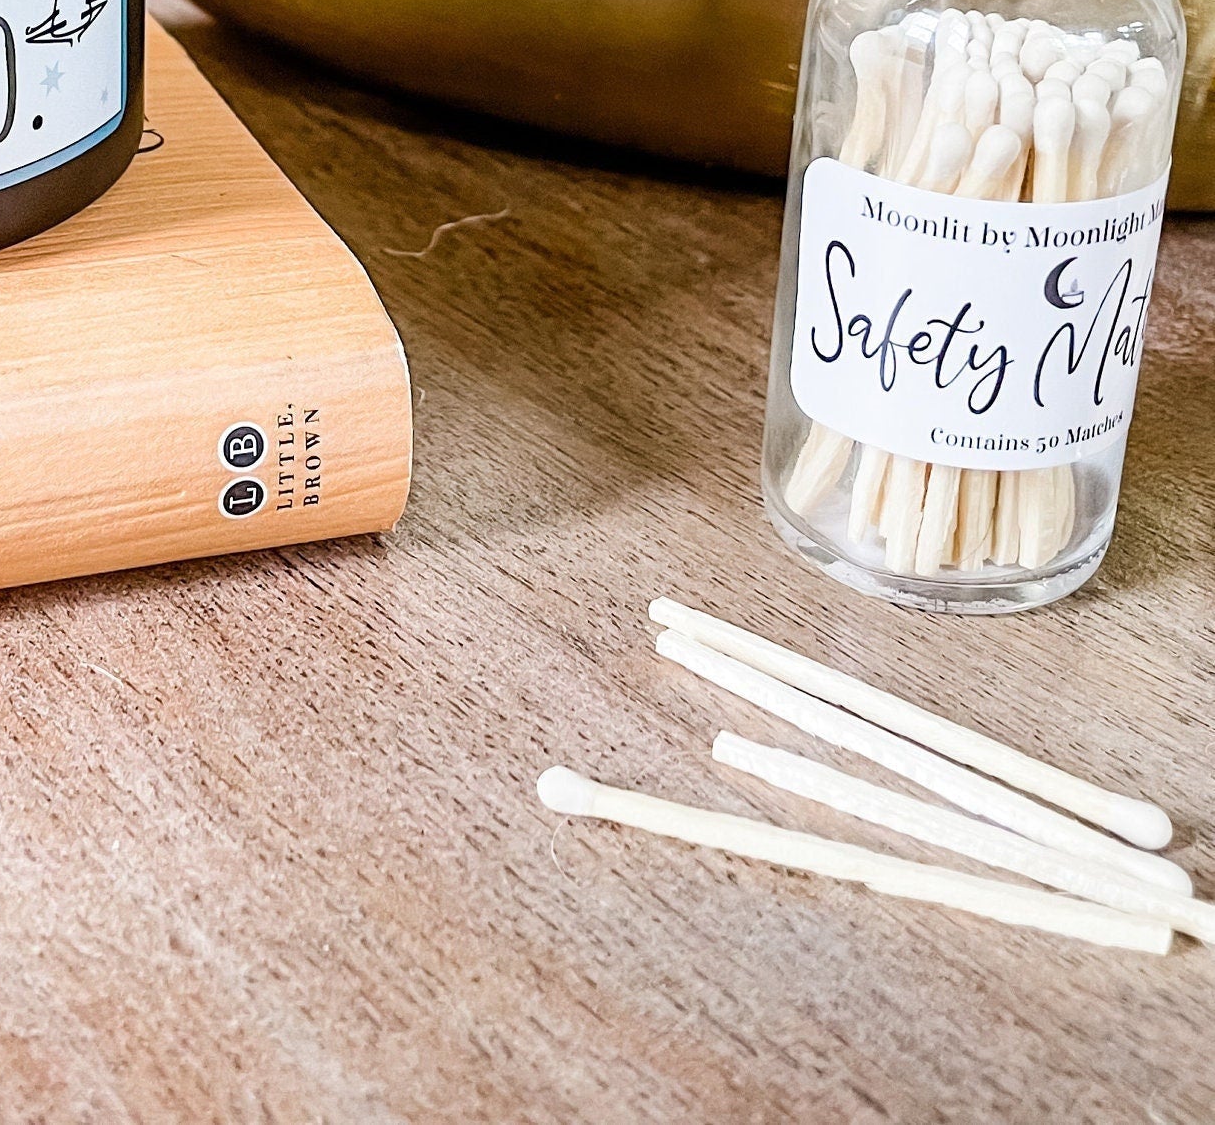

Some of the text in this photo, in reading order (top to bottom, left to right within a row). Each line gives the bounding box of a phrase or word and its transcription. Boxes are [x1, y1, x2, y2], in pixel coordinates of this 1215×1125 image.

[860, 195, 971, 244] Moonlit
[982, 222, 1016, 254] by
[1025, 211, 1146, 249] Moonlight
[811, 240, 1153, 416] Safety Mat
[276, 403, 296, 511] LITTLE,
[303, 408, 322, 507] BROWN
[930, 410, 1124, 454] Contains 50 Matches
